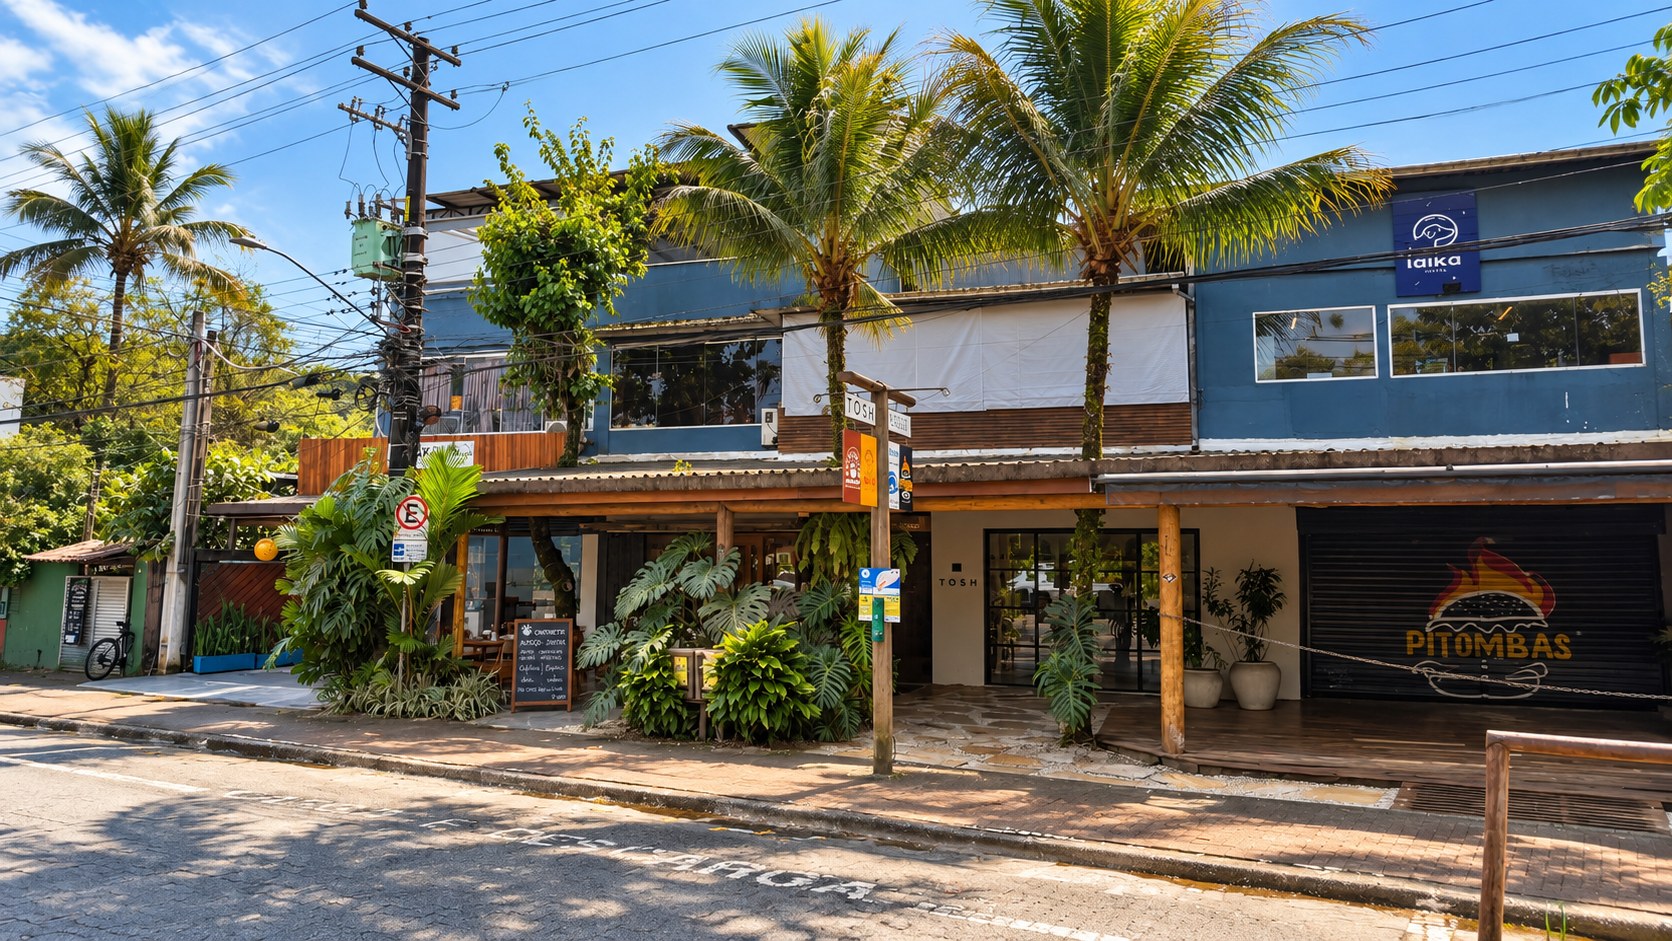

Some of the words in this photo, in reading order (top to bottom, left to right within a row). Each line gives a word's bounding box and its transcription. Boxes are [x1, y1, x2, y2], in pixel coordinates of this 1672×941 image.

[847, 397, 874, 422] TOSH
[404, 503, 418, 524] E
[938, 578, 977, 587] TOSH
[1406, 629, 1572, 660] PITOMBAS
